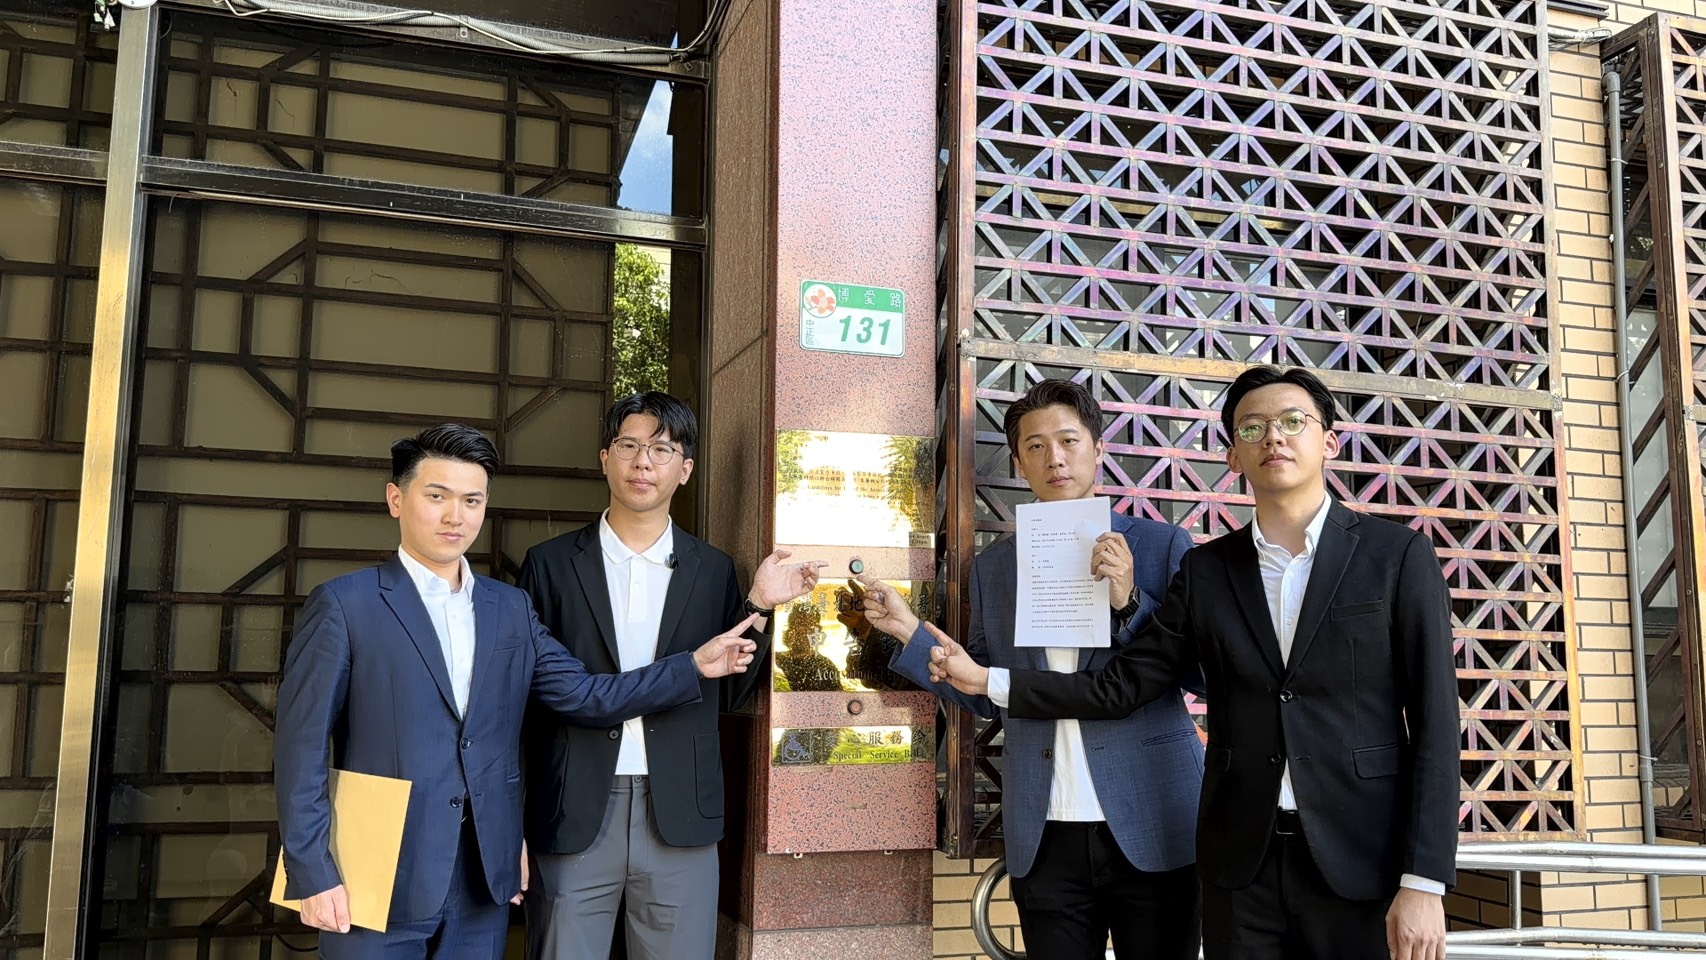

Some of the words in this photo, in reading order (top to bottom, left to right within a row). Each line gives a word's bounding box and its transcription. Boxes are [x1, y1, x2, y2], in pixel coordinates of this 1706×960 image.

[838, 287, 901, 308] 博愛路
[805, 319, 815, 346] 中正區
[838, 315, 891, 346] 131
[814, 667, 874, 681] Accation
[832, 751, 862, 762] Special
[869, 750, 899, 759] Service
